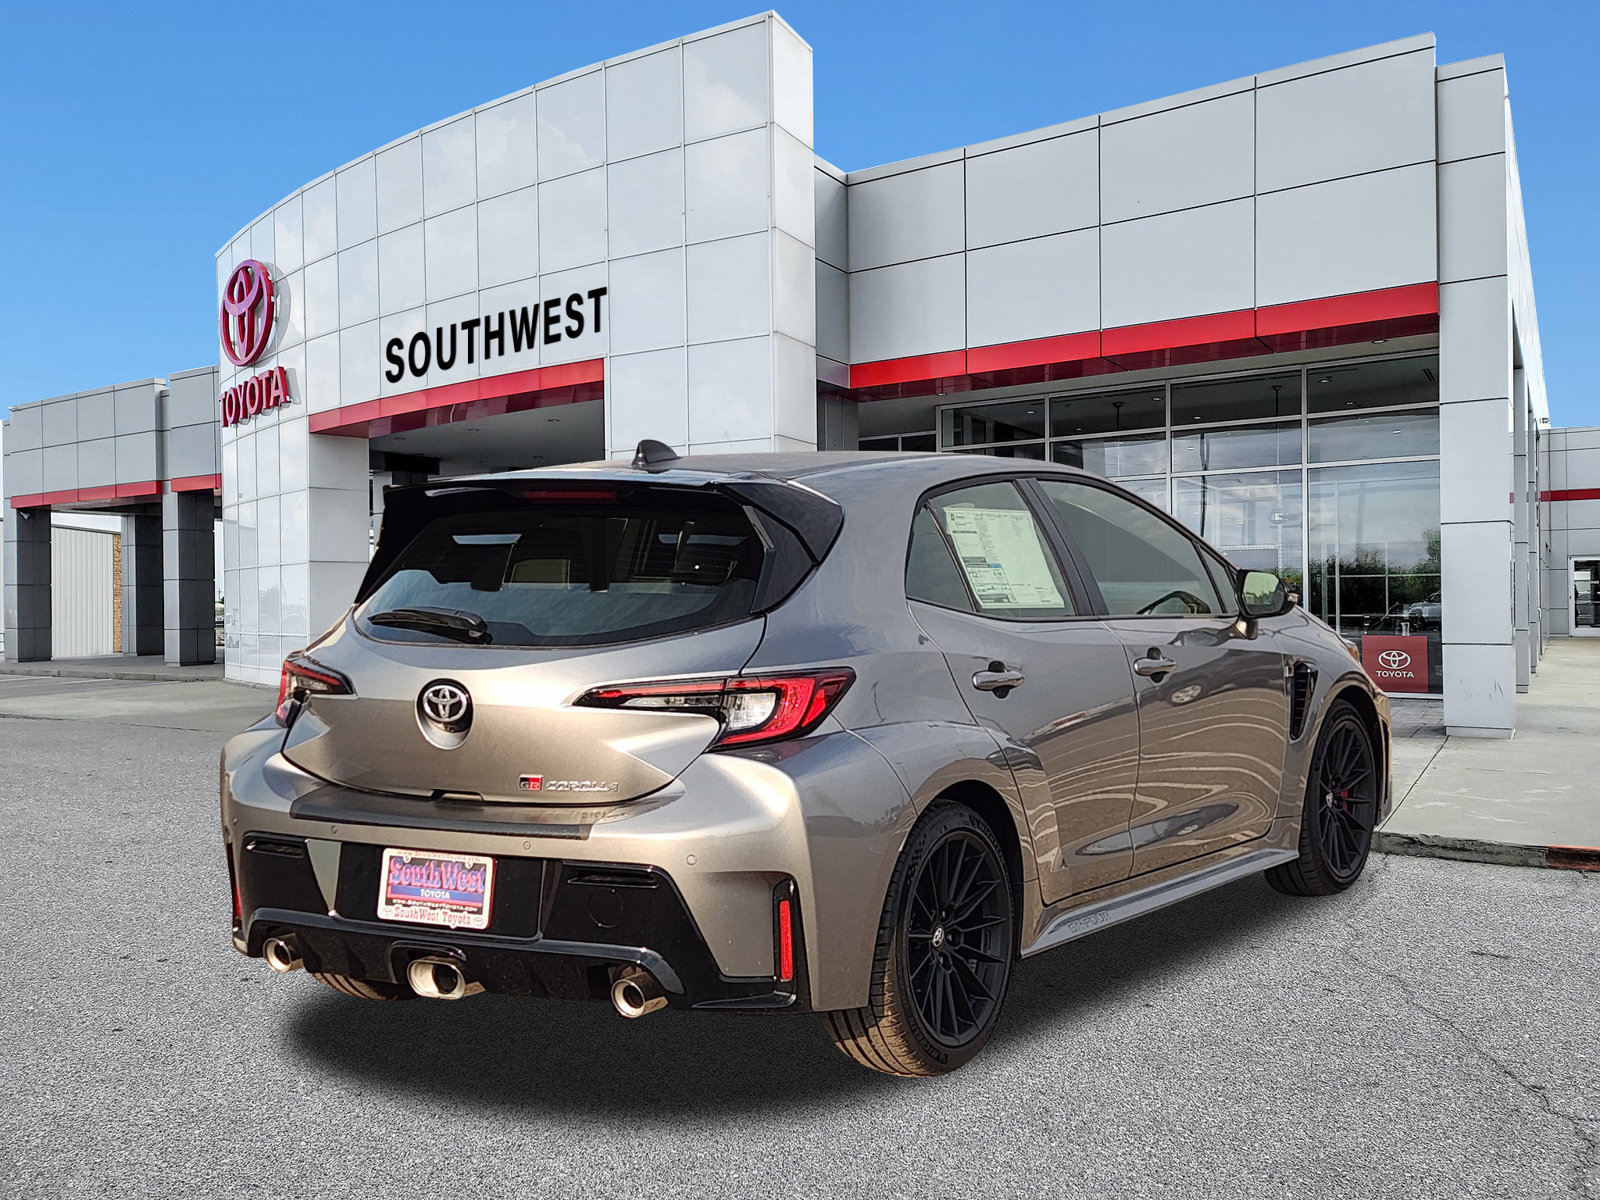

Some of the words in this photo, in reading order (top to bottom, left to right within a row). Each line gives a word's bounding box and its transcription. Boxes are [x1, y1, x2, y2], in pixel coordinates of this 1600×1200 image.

[385, 287, 608, 383] SOUTHWEST
[218, 366, 291, 427] TOYOTA
[1375, 670, 1415, 678] TOYOTA
[519, 779, 541, 791] GR
[545, 780, 619, 792] COROLLA
[388, 856, 485, 893] SouthWest
[420, 888, 450, 899] TOYOTA
[394, 906, 440, 922] SouthWest
[442, 911, 471, 926] Toyota
